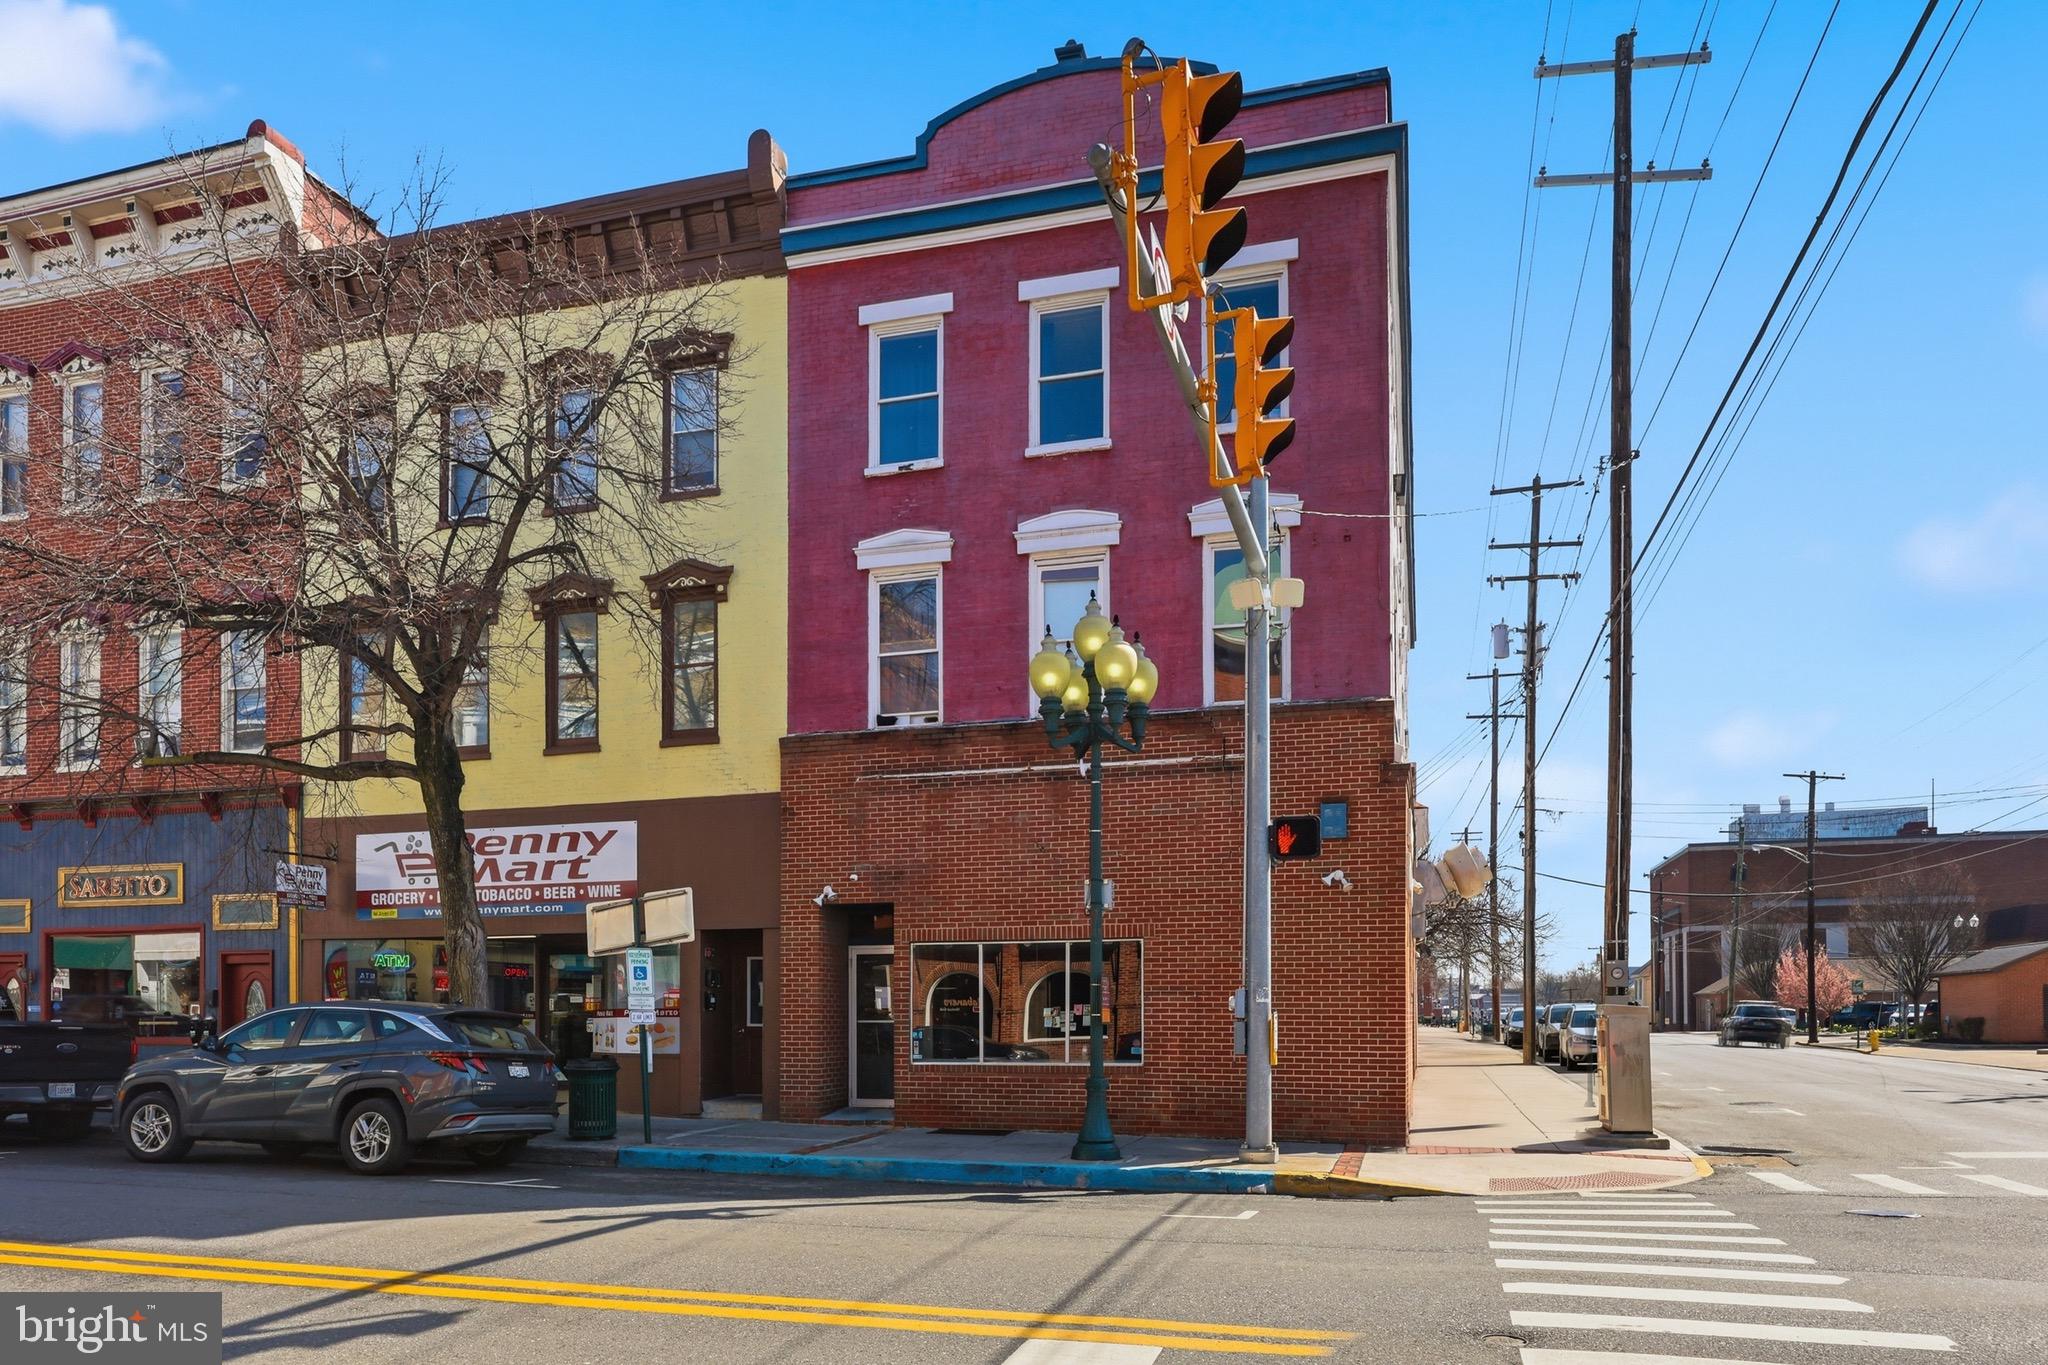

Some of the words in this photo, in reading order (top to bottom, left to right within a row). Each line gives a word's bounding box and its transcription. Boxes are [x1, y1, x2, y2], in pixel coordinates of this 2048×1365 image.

[296, 866, 324, 880] Penny
[70, 875, 167, 898] SARETTO
[299, 879, 321, 891] Mart
[371, 891, 425, 906] GROCERY
[475, 887, 531, 902] TOBACCO
[543, 885, 576, 899] BEER
[587, 884, 621, 898] WINE
[424, 903, 563, 916] wwnnymart.com
[374, 954, 410, 968] ATM
[504, 968, 529, 977] OPEN
